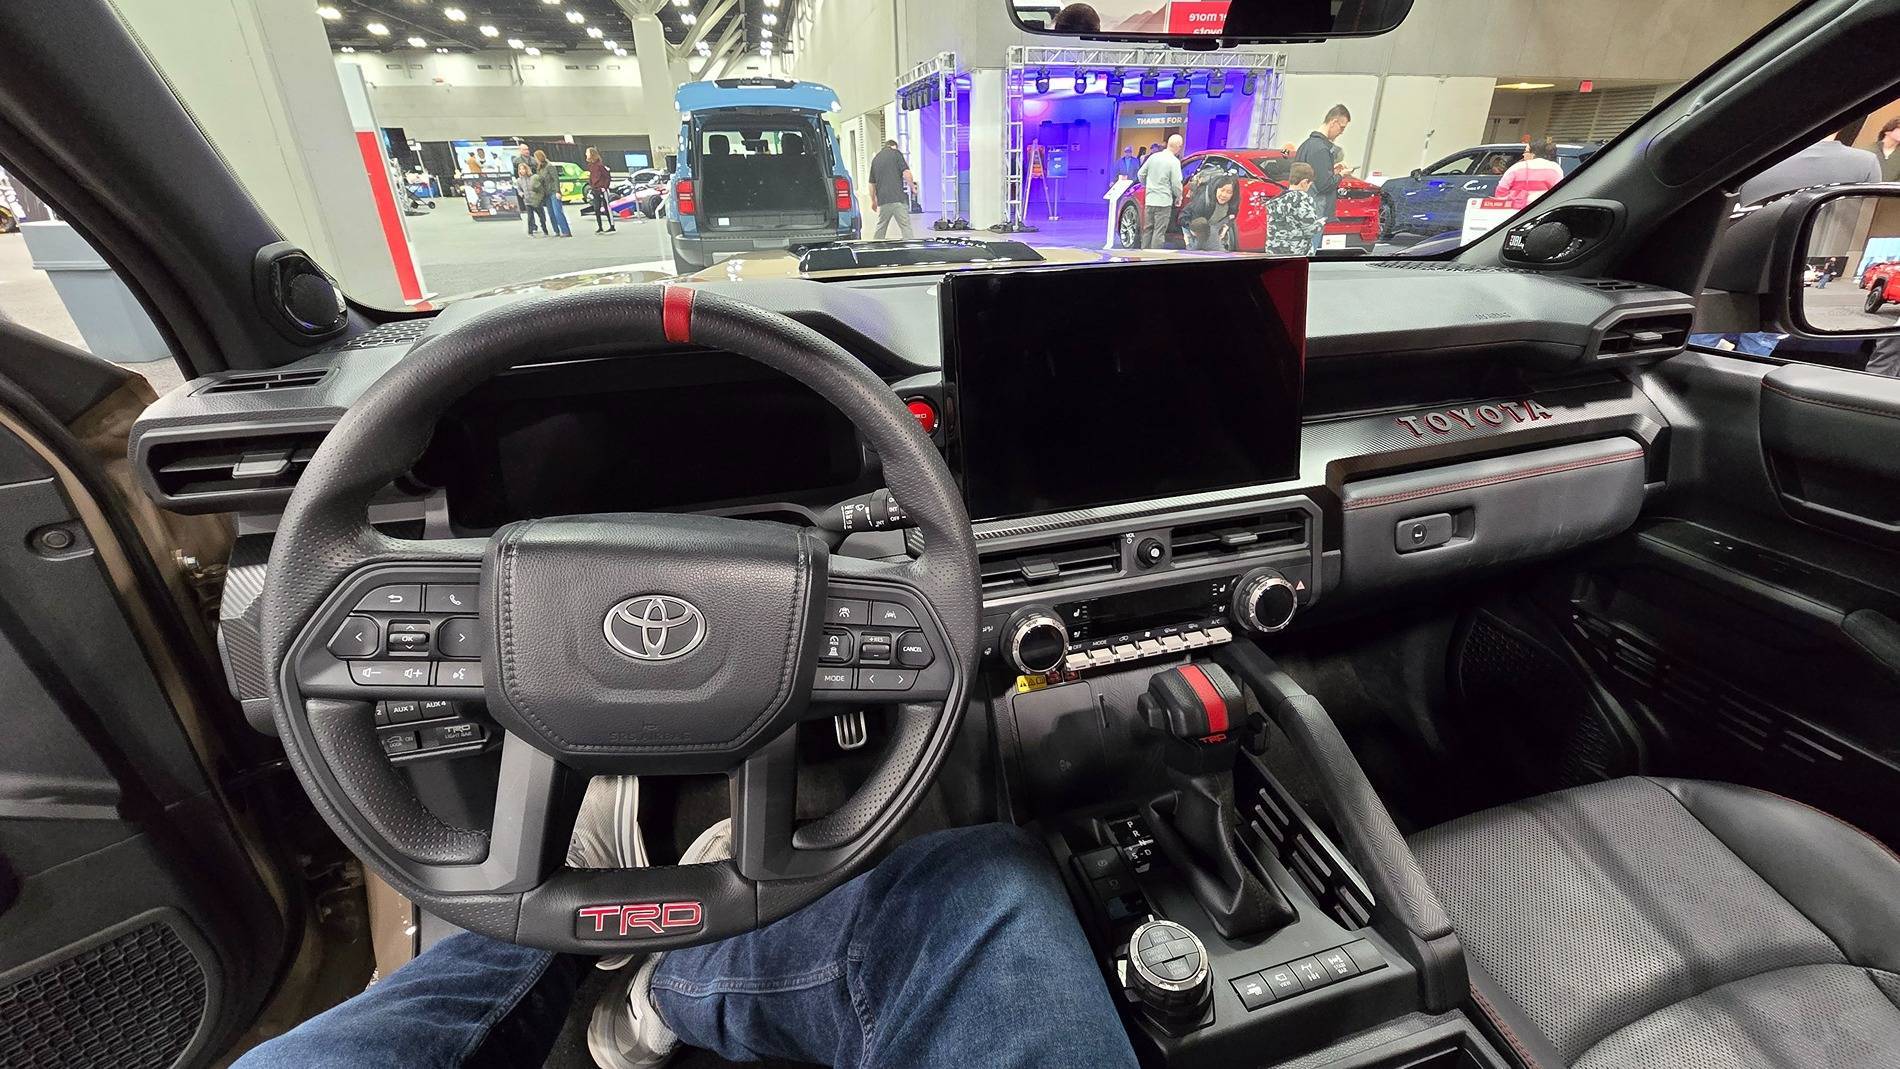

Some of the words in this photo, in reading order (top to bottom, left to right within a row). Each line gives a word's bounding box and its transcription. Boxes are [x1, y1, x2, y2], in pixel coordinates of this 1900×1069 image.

[1136, 117, 1165, 125] THANKS
[1395, 399, 1553, 438] TOYOTA
[426, 701, 440, 709] AUX
[393, 706, 409, 714] AUX
[443, 724, 471, 734] TRD
[1198, 733, 1227, 744] TRD
[1127, 821, 1134, 829] P
[1132, 830, 1141, 838] R
[1132, 852, 1139, 860] S
[578, 901, 702, 936] TRD
[1279, 980, 1292, 988] VIEW
